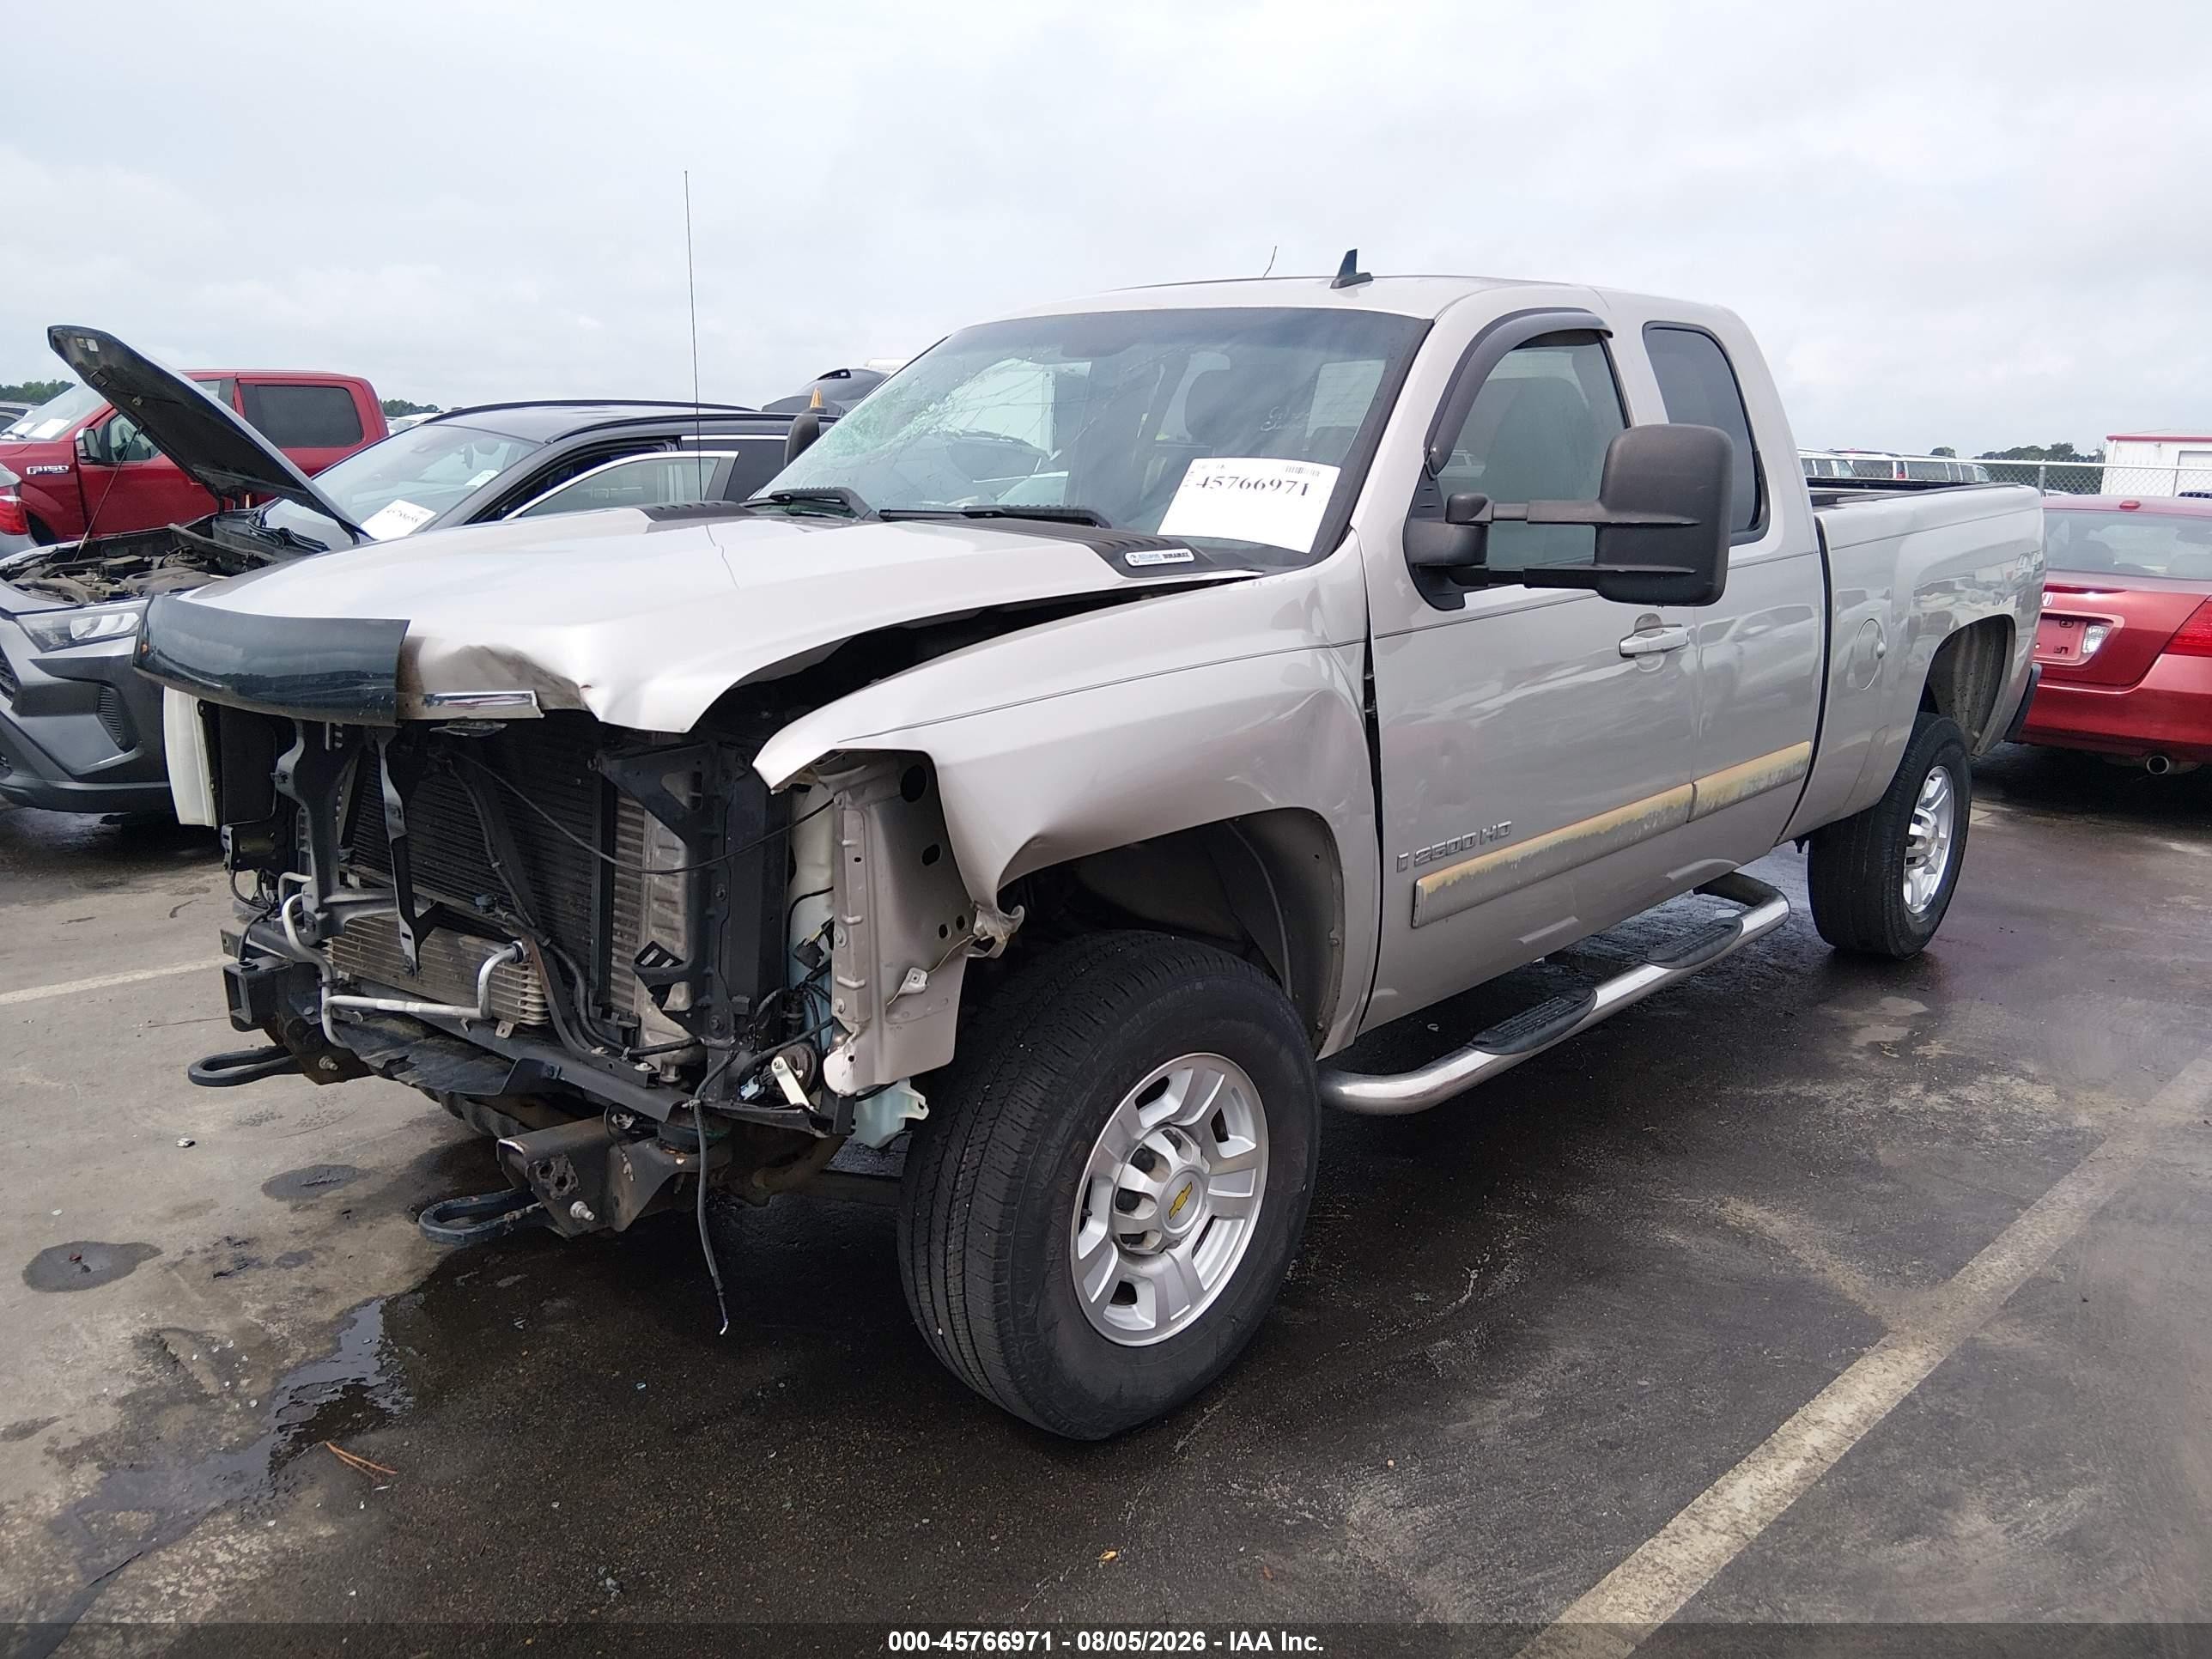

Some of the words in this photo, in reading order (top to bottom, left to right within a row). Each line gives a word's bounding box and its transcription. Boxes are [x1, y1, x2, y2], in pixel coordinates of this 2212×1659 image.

[1195, 476, 1310, 496] 45766971
[1413, 831, 1477, 867] 2500
[1480, 820, 1512, 846] HD
